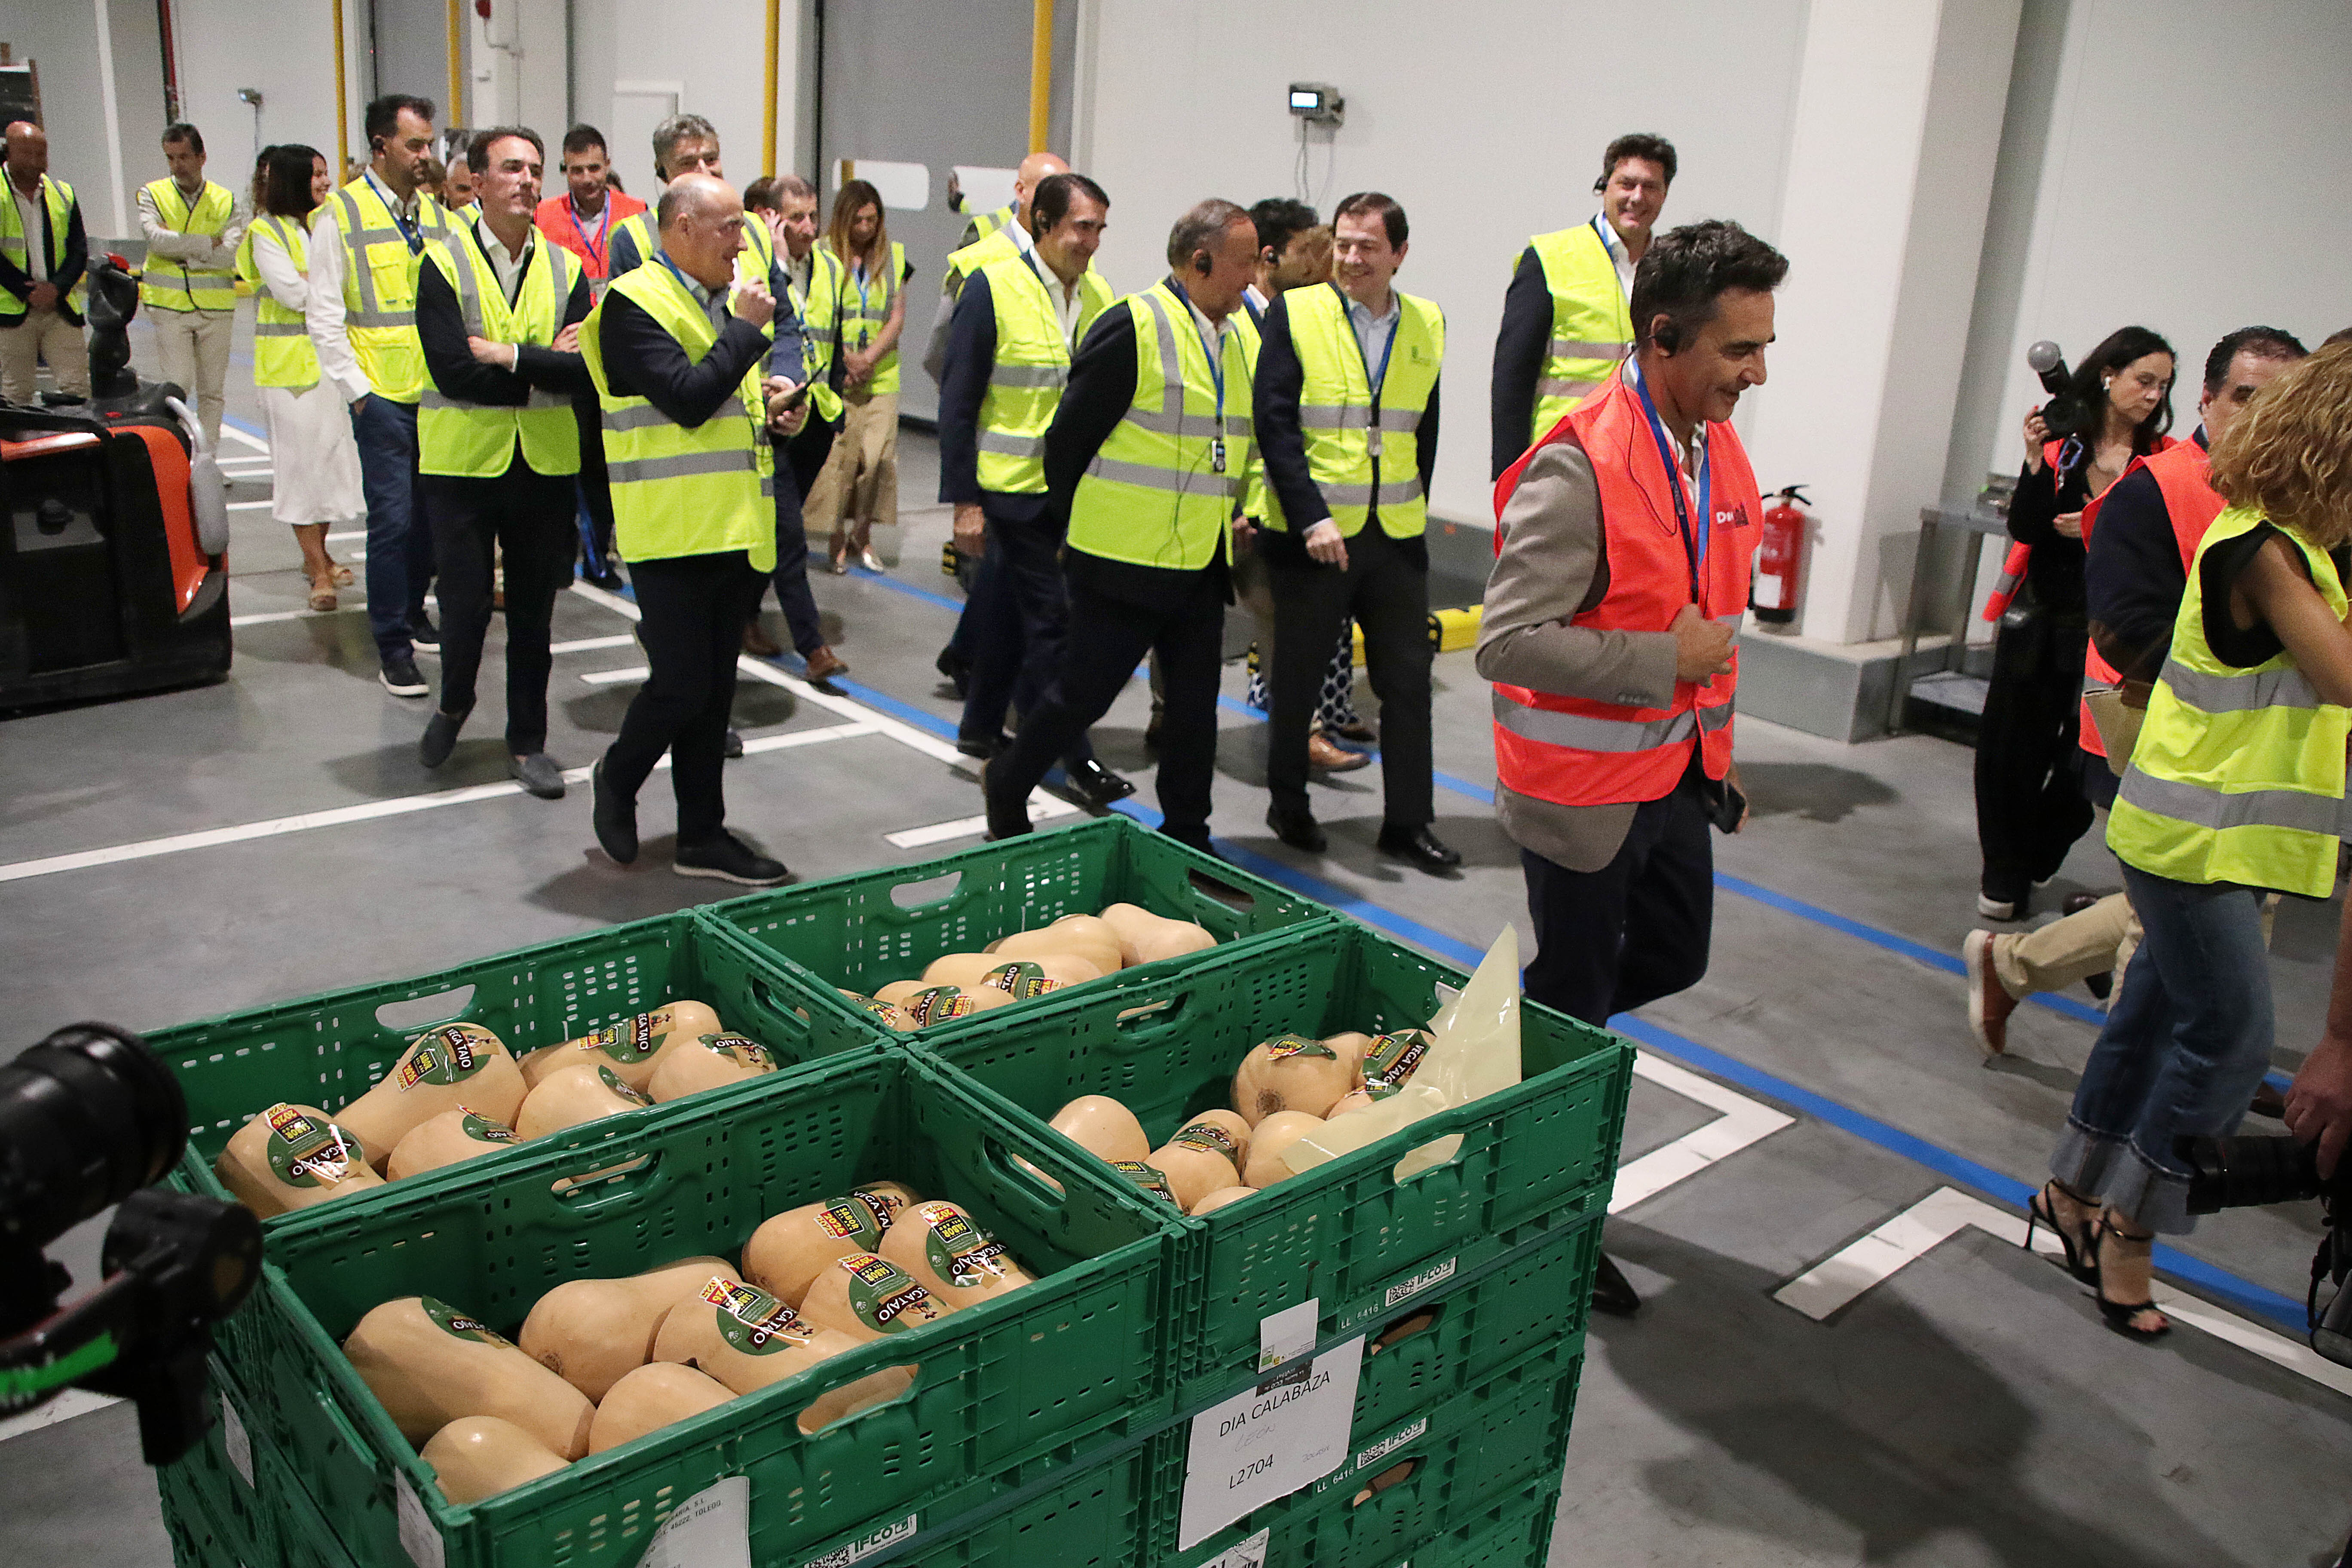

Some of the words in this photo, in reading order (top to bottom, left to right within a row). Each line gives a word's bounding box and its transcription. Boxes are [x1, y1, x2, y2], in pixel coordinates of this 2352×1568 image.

[1002, 967, 1018, 988] TAJO
[1027, 980, 1037, 998] ABOR
[638, 1013, 648, 1028] EGA
[637, 1027, 649, 1050] TAJO
[447, 1029, 463, 1045] VEGA
[457, 1044, 472, 1068] TAJO
[1402, 1044, 1425, 1064] VEGA
[404, 1065, 417, 1081] 2026
[273, 1109, 297, 1126] 2026
[285, 1123, 311, 1139] SABOR
[1219, 1137, 1231, 1145] TA
[1153, 1191, 1172, 1200] VE
[839, 1207, 859, 1229] SABOR
[854, 1191, 880, 1209] VEGA
[878, 1210, 891, 1228] TAJ
[816, 1217, 836, 1237] 2025
[824, 1213, 845, 1234] 2026
[942, 1222, 967, 1237] SABOR
[978, 1244, 1007, 1257] VEGA
[952, 1255, 980, 1274] TAJO
[865, 1267, 890, 1282] SABOR
[1418, 1266, 1441, 1285] IFCO
[702, 1279, 718, 1298] 025
[904, 1287, 928, 1300] EGA
[775, 1310, 793, 1322] GA
[879, 1297, 909, 1321] TAJO
[1341, 1317, 1351, 1329] LL
[1220, 1412, 1246, 1437] DIA
[1252, 1371, 1330, 1419] CALABAZA
[1388, 1427, 1412, 1447] IFCO
[1230, 1454, 1274, 1489] L2704
[1317, 1482, 1327, 1493] LL
[1333, 1467, 1354, 1484] 6416
[854, 1526, 893, 1553] IFCO
